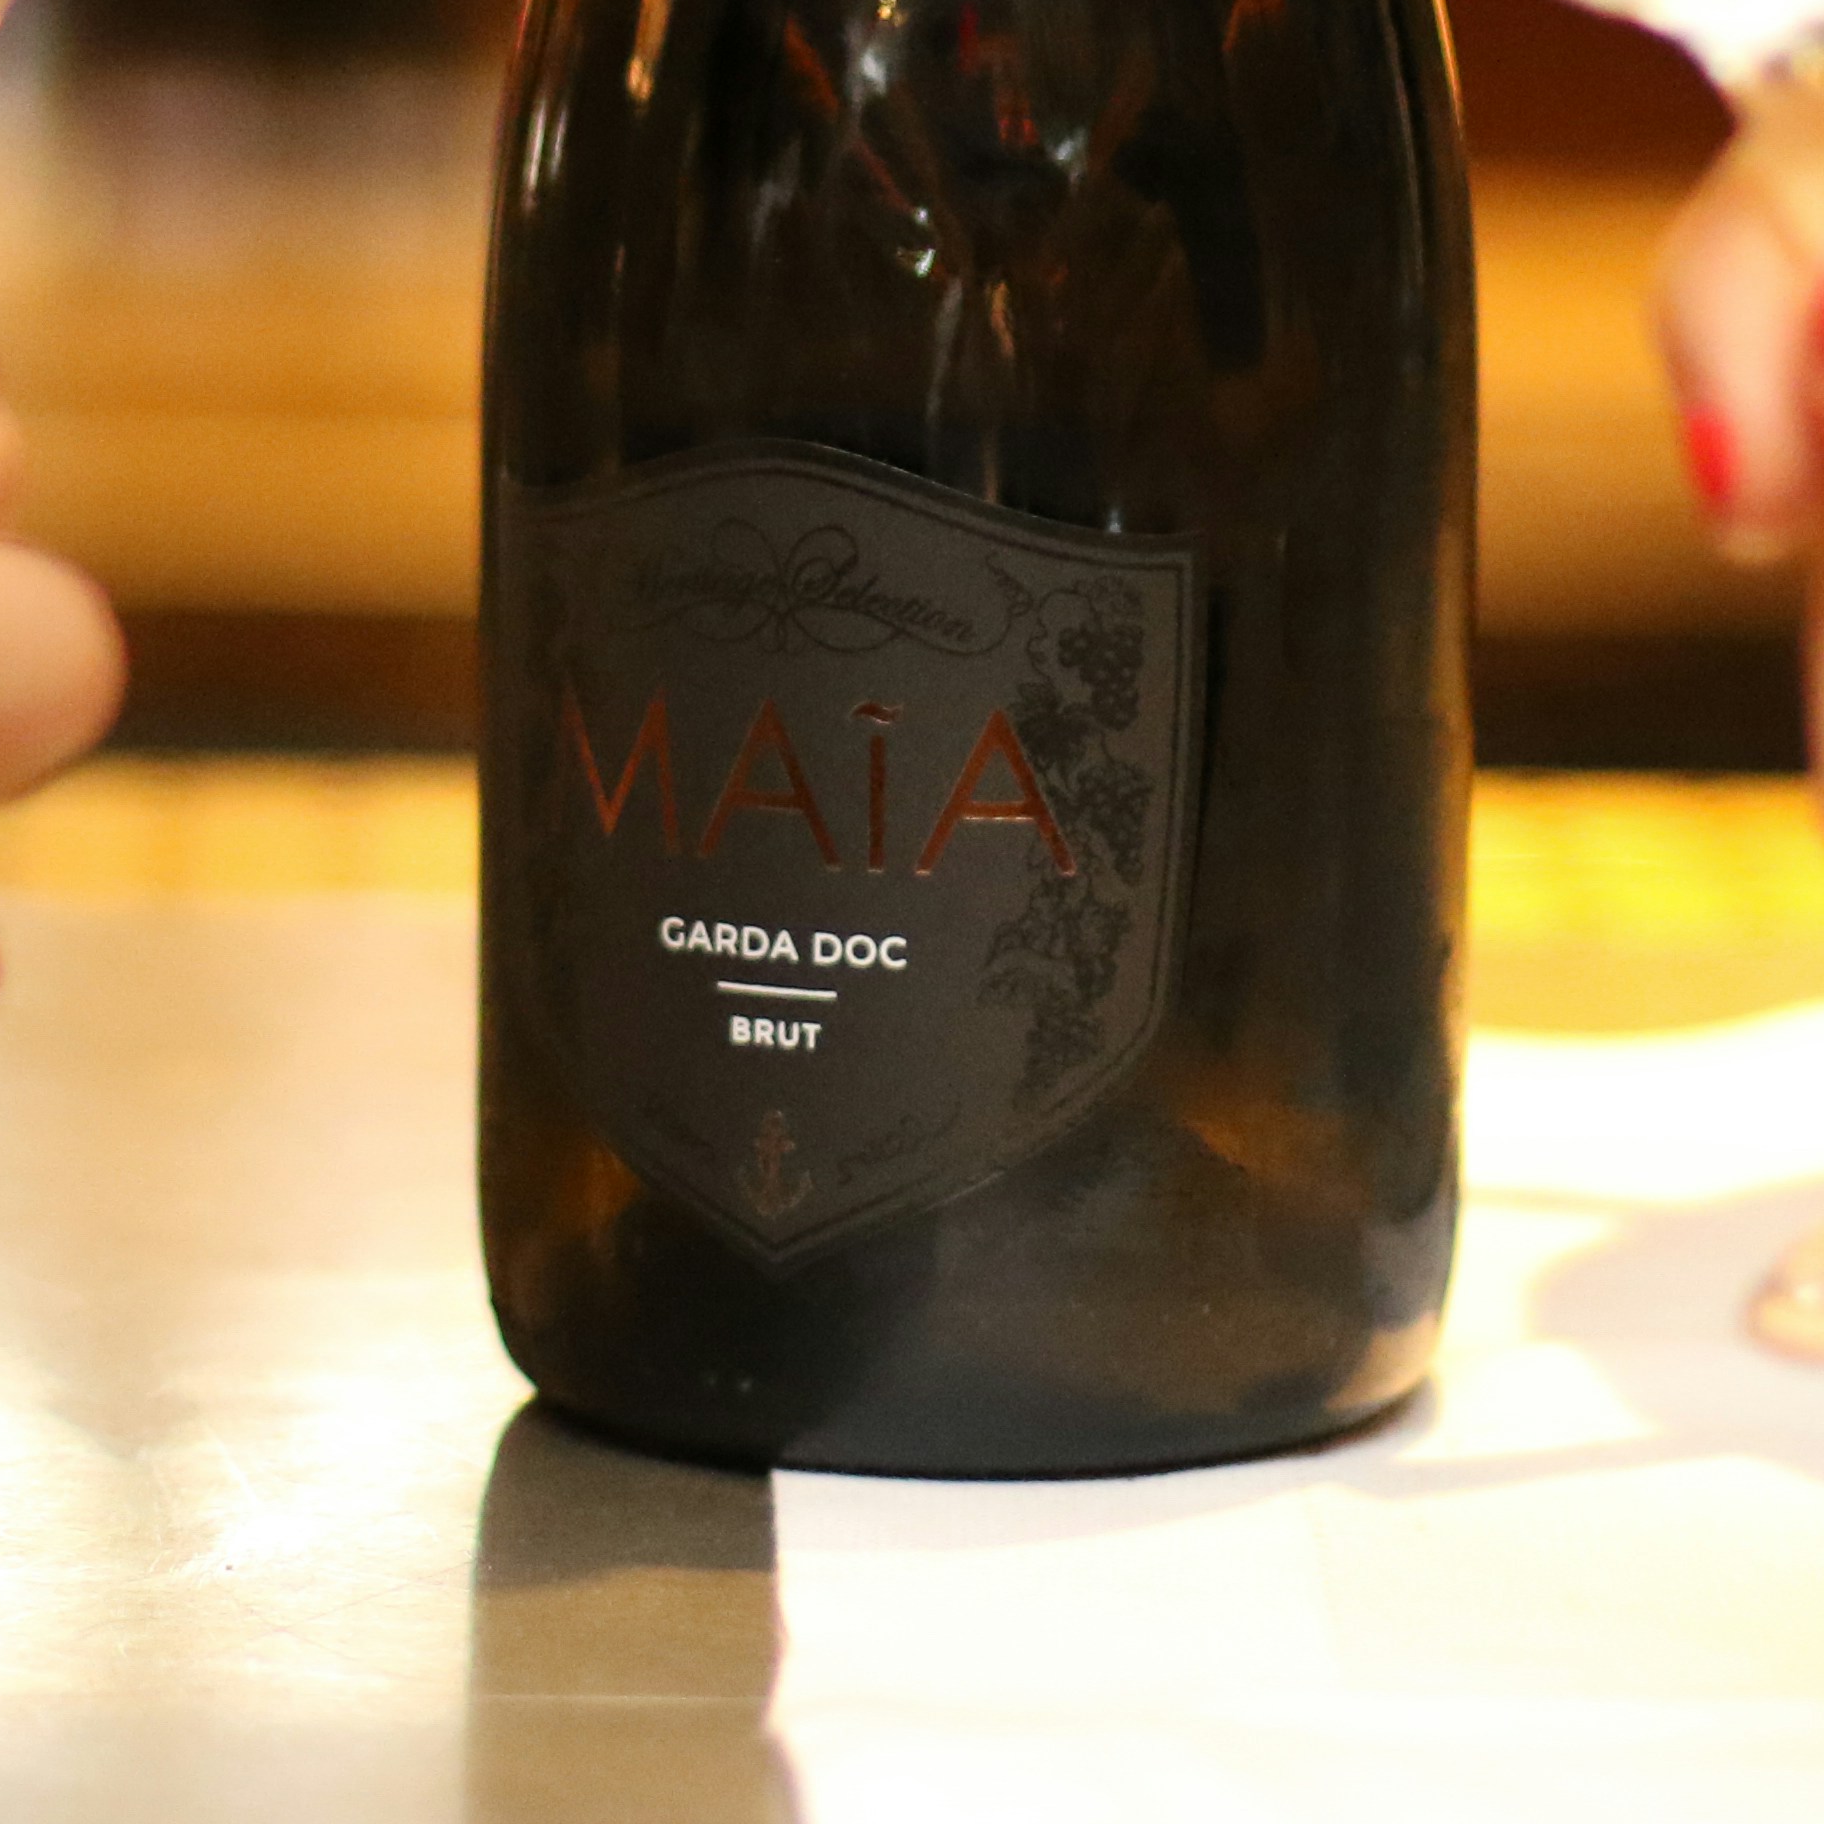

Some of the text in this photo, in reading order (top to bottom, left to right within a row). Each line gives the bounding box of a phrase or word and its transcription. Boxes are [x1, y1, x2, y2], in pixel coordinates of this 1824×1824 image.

[660, 916, 908, 970] GARDA DOC
[730, 1014, 822, 1052] BRUT
